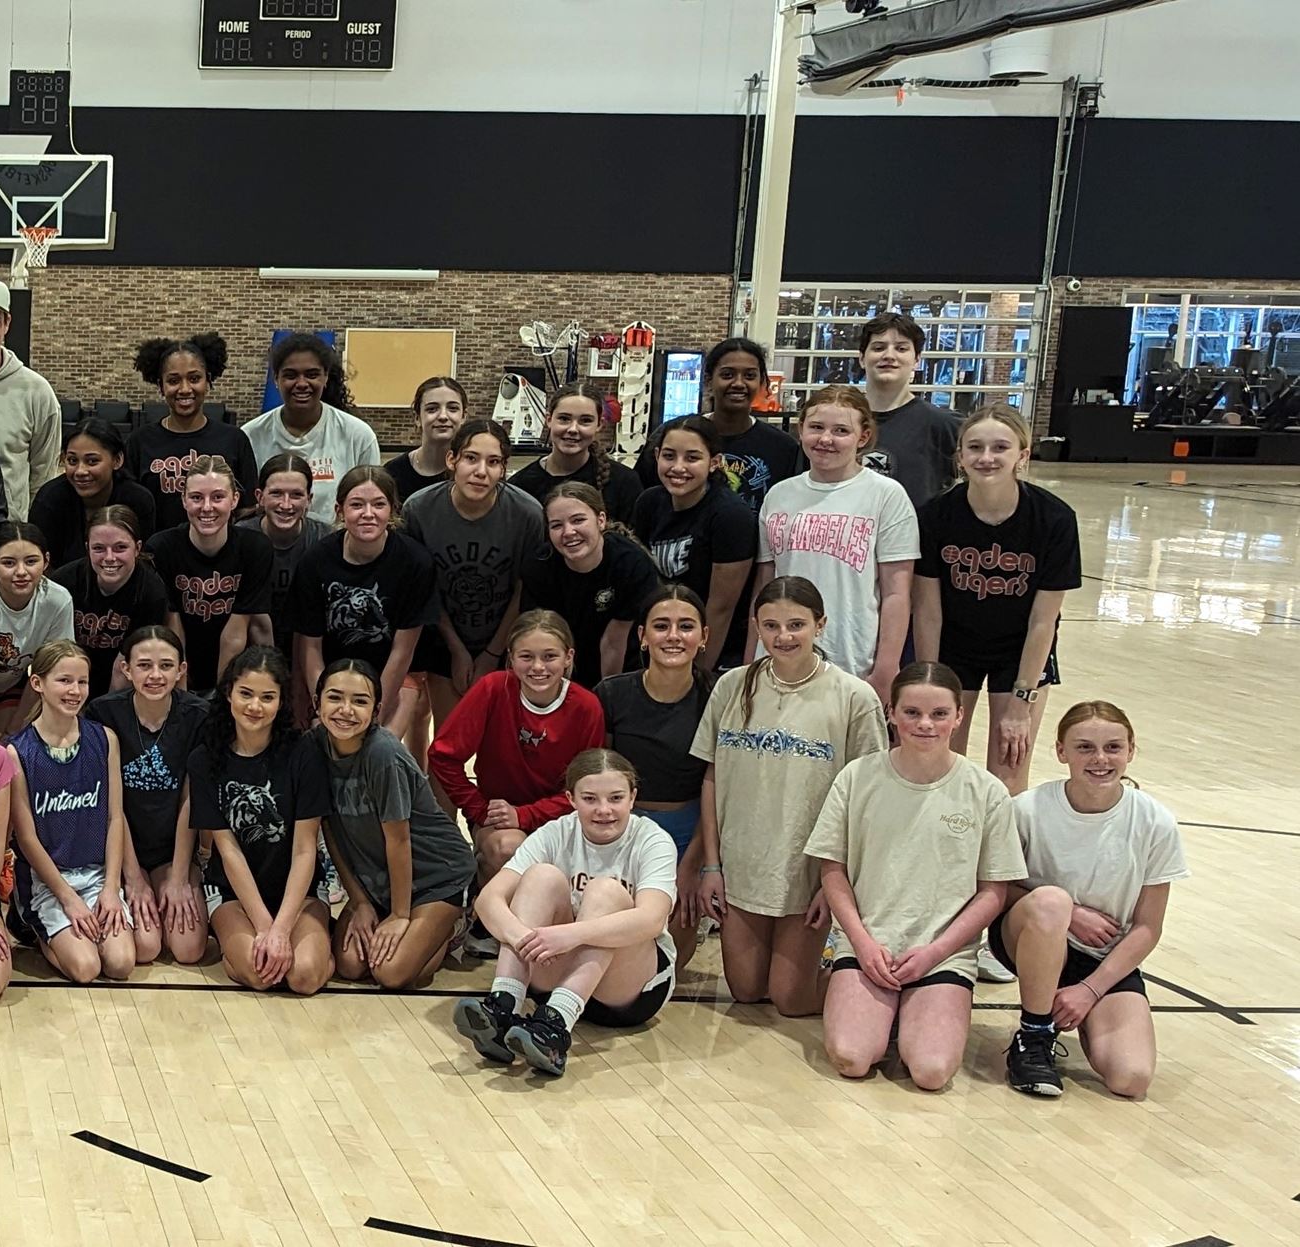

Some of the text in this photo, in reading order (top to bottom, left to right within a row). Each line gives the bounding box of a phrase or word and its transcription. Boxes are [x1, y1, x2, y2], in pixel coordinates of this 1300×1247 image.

[219, 21, 250, 33] HOME
[285, 30, 312, 39] PERIOD
[346, 23, 381, 35] GUEST
[767, 513, 875, 573] OS ANGELES
[433, 542, 515, 575] OGDEN
[941, 543, 1036, 573] ogden
[950, 572, 1030, 600] tigers
[35, 781, 101, 818] Untamed
[939, 814, 960, 825] Hard
